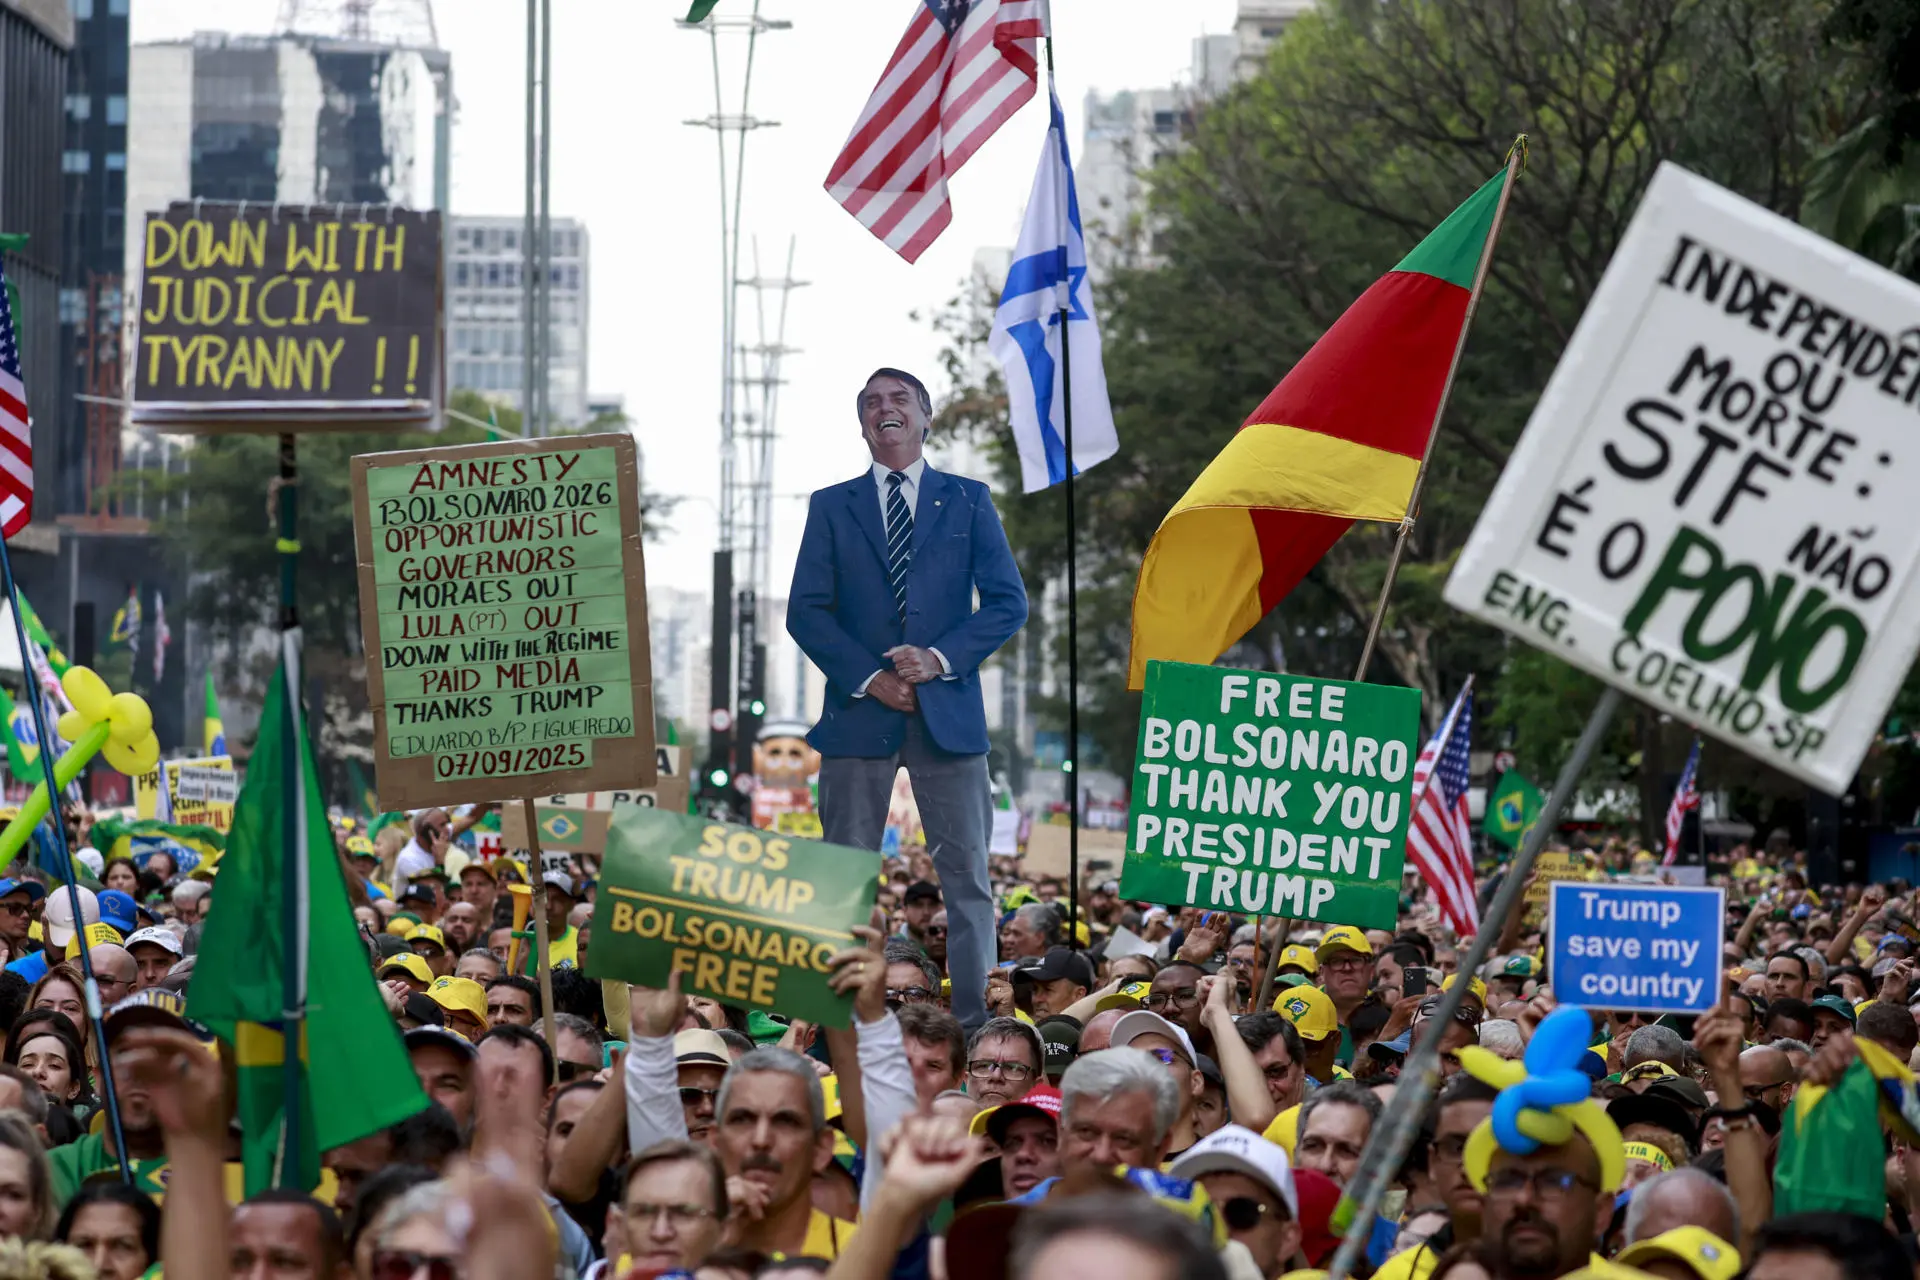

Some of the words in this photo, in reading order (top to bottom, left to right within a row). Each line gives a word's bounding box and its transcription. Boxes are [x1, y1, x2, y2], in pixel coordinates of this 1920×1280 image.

[145, 218, 268, 271] DOWN
[286, 221, 405, 272] WITH
[144, 274, 370, 327] JUDICIAL
[142, 334, 345, 392] TYRANNY
[1763, 352, 1845, 414] OU
[409, 453, 580, 494] AMNESTY
[378, 487, 546, 526] BOLSONARO
[553, 482, 612, 508] 2026
[1603, 400, 1793, 526] STF
[1786, 524, 1891, 600] NÃO
[385, 509, 598, 553] OPPORTUNISTIC
[399, 546, 575, 583] GOVERNORS
[399, 579, 512, 610] MORAES
[527, 572, 579, 600] OUT
[1537, 477, 1596, 558] É
[1597, 519, 1647, 581] O
[1623, 523, 1869, 714] POVO
[524, 602, 585, 630] OUT
[384, 644, 451, 669] DOWN
[461, 637, 508, 662] WITH
[515, 638, 541, 658] THE
[545, 628, 620, 654] REGIME
[1483, 569, 1578, 648] ENG.
[1611, 632, 1827, 761] COELHO-SP
[419, 666, 481, 694] PAID
[496, 658, 580, 689] MEDIA
[1220, 675, 1347, 722] FREE
[393, 696, 492, 725] THANKS
[511, 685, 604, 715] TRUMP
[390, 730, 482, 757] EDUARDO
[533, 716, 631, 740] FIGUEIREDO
[1143, 717, 1408, 783] BOLSONARO
[437, 744, 585, 777] 07/09/2025
[1139, 763, 1292, 819] THANK
[1312, 780, 1401, 834] YOU
[698, 824, 793, 872] SOS
[1135, 813, 1391, 880] PRESIDENT
[669, 855, 815, 914] TRUMP
[1181, 862, 1336, 919] TRUMP
[1579, 892, 1681, 929] Trump
[611, 901, 838, 974] BOLSONARO
[1567, 934, 1641, 957] save
[1651, 939, 1700, 968] my
[672, 948, 779, 1006] FREE
[1580, 971, 1704, 1006] country
[1052, 1042, 1069, 1052] YORK
